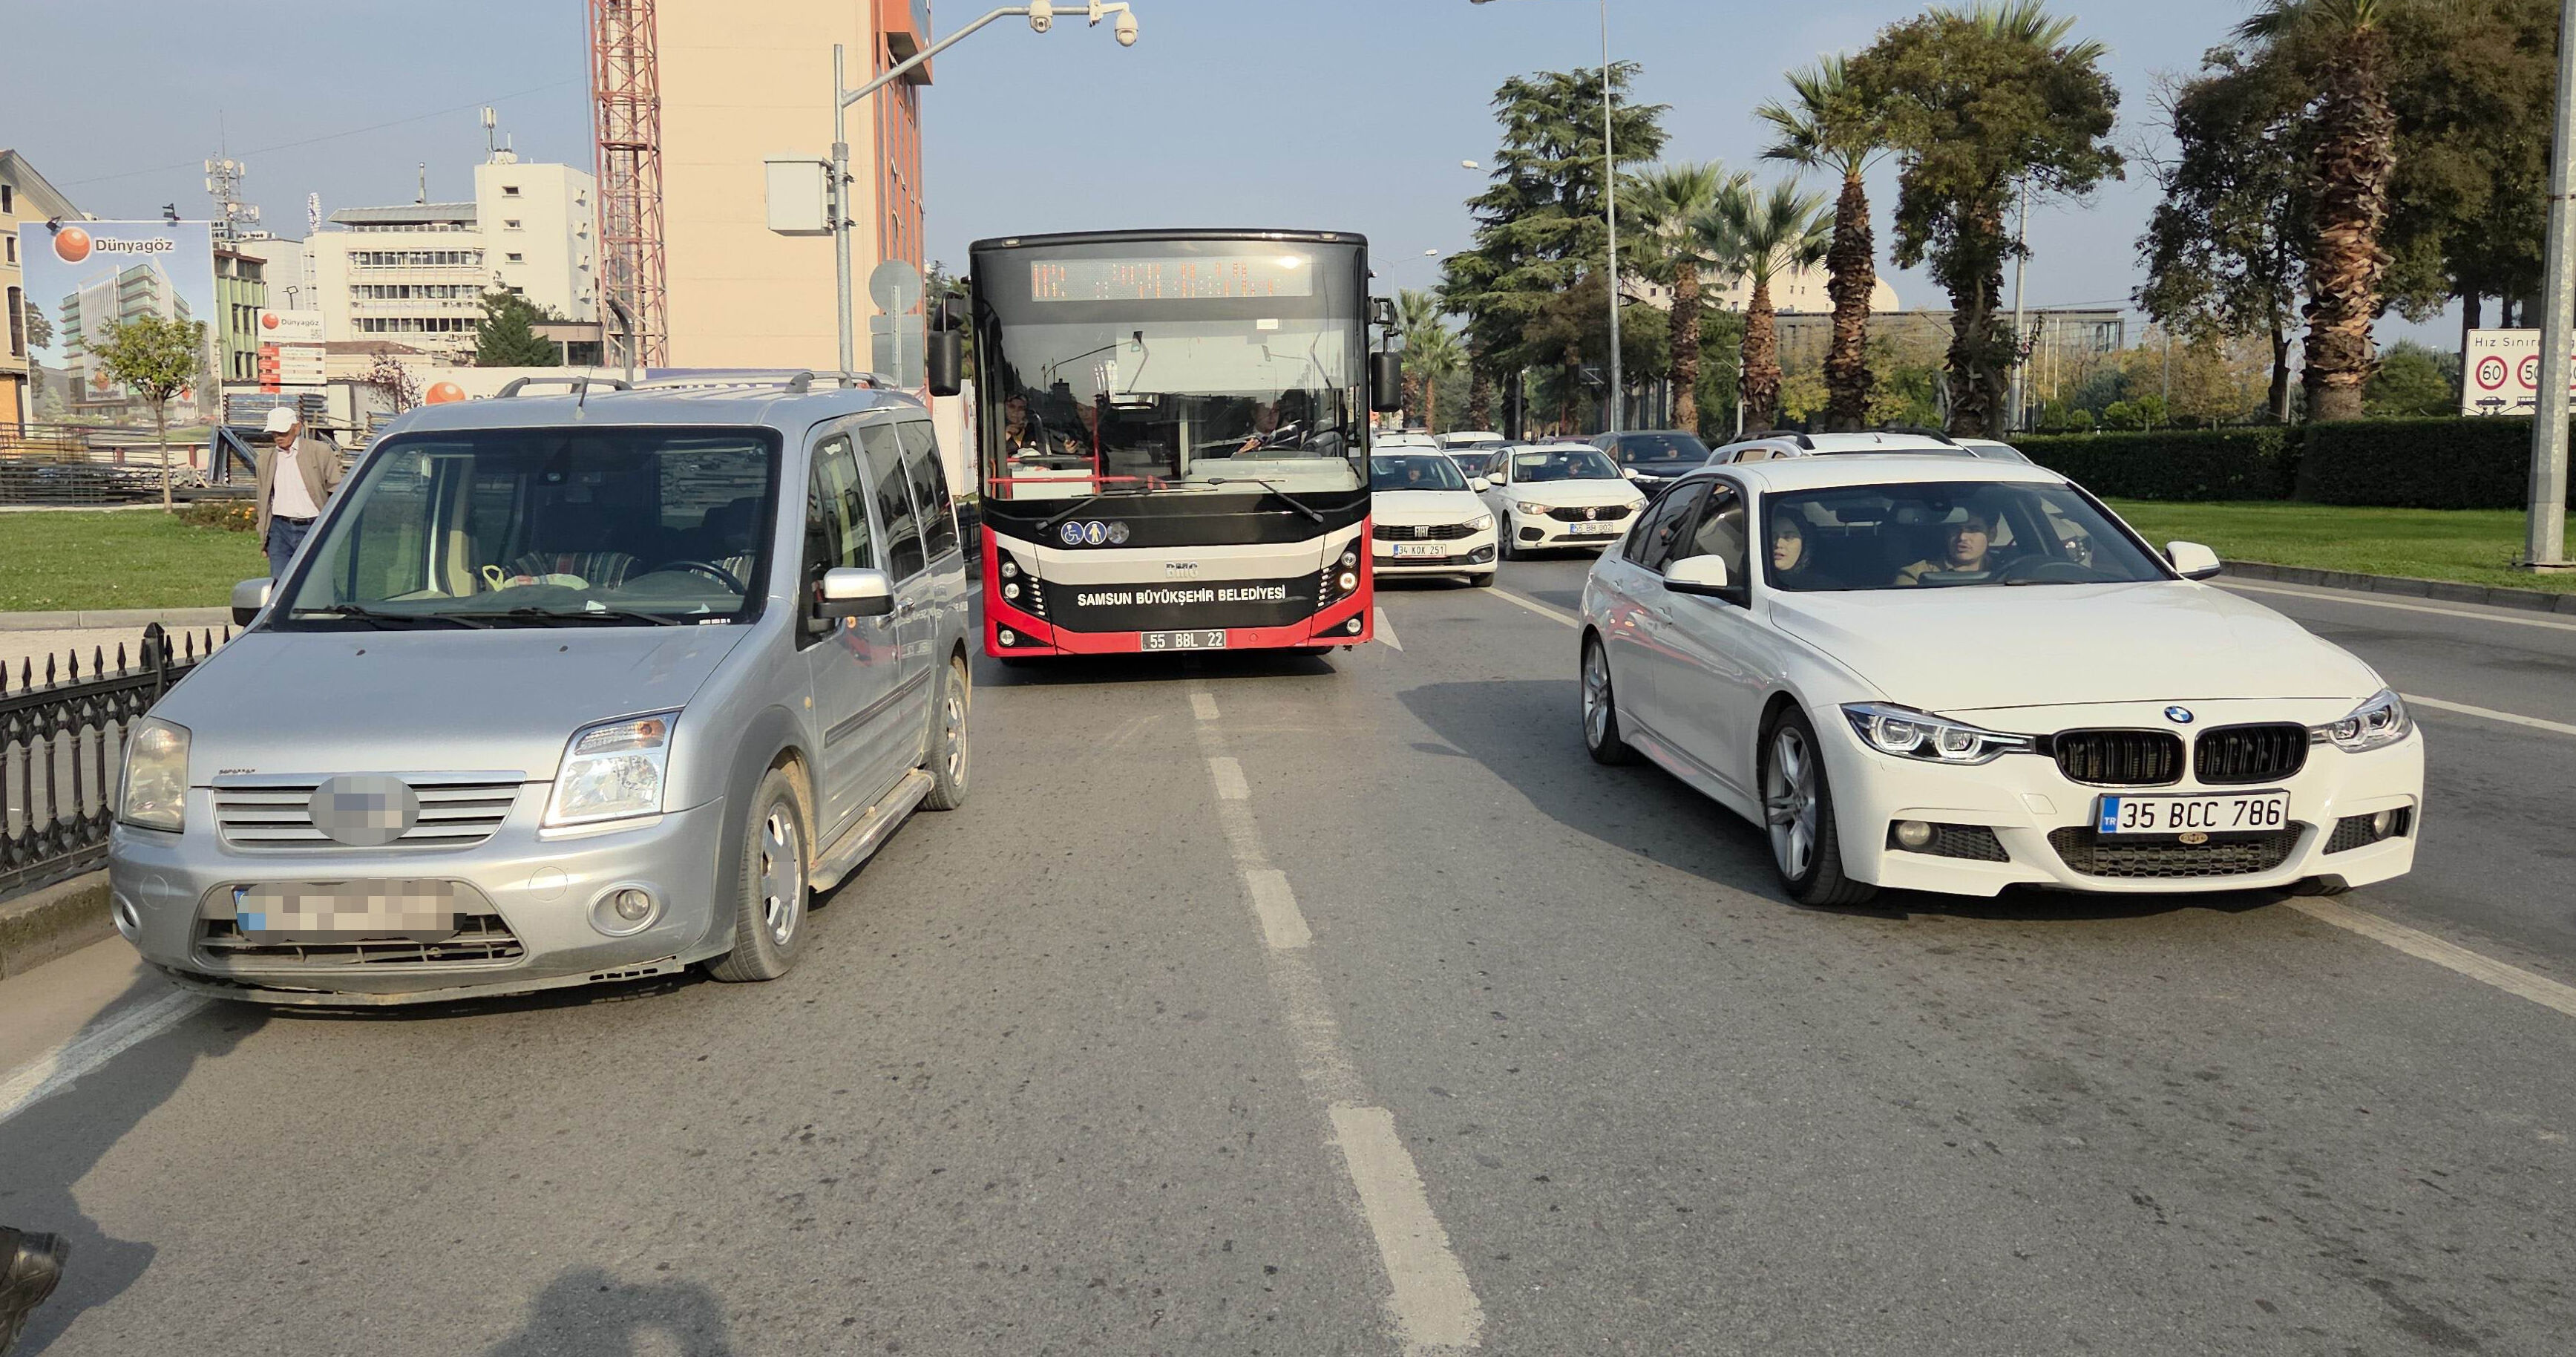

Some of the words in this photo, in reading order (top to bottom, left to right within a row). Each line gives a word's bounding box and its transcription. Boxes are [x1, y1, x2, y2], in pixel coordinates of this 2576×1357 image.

[96, 239, 173, 254] Dünyagöz
[281, 318, 319, 327] Dünyagöz
[2475, 338, 2496, 347] Hız
[2503, 338, 2540, 347] Sınır
[2482, 365, 2501, 380] 60
[1415, 526, 1429, 537] FIAT
[1412, 546, 1426, 555] KOK
[1166, 562, 1199, 578] BMC
[1078, 592, 1132, 606] SAMSUN
[1136, 588, 1214, 606] BÜYÜKŞEHİR
[1219, 584, 1285, 601] BELEDİYESİ
[1150, 634, 1165, 648] 55
[1176, 633, 1198, 647] BBL
[1207, 632, 1222, 646] 22
[2105, 817, 2116, 825] TR
[2123, 802, 2155, 828] 35
[2169, 801, 2218, 828] BCC
[2232, 799, 2281, 826] 786
